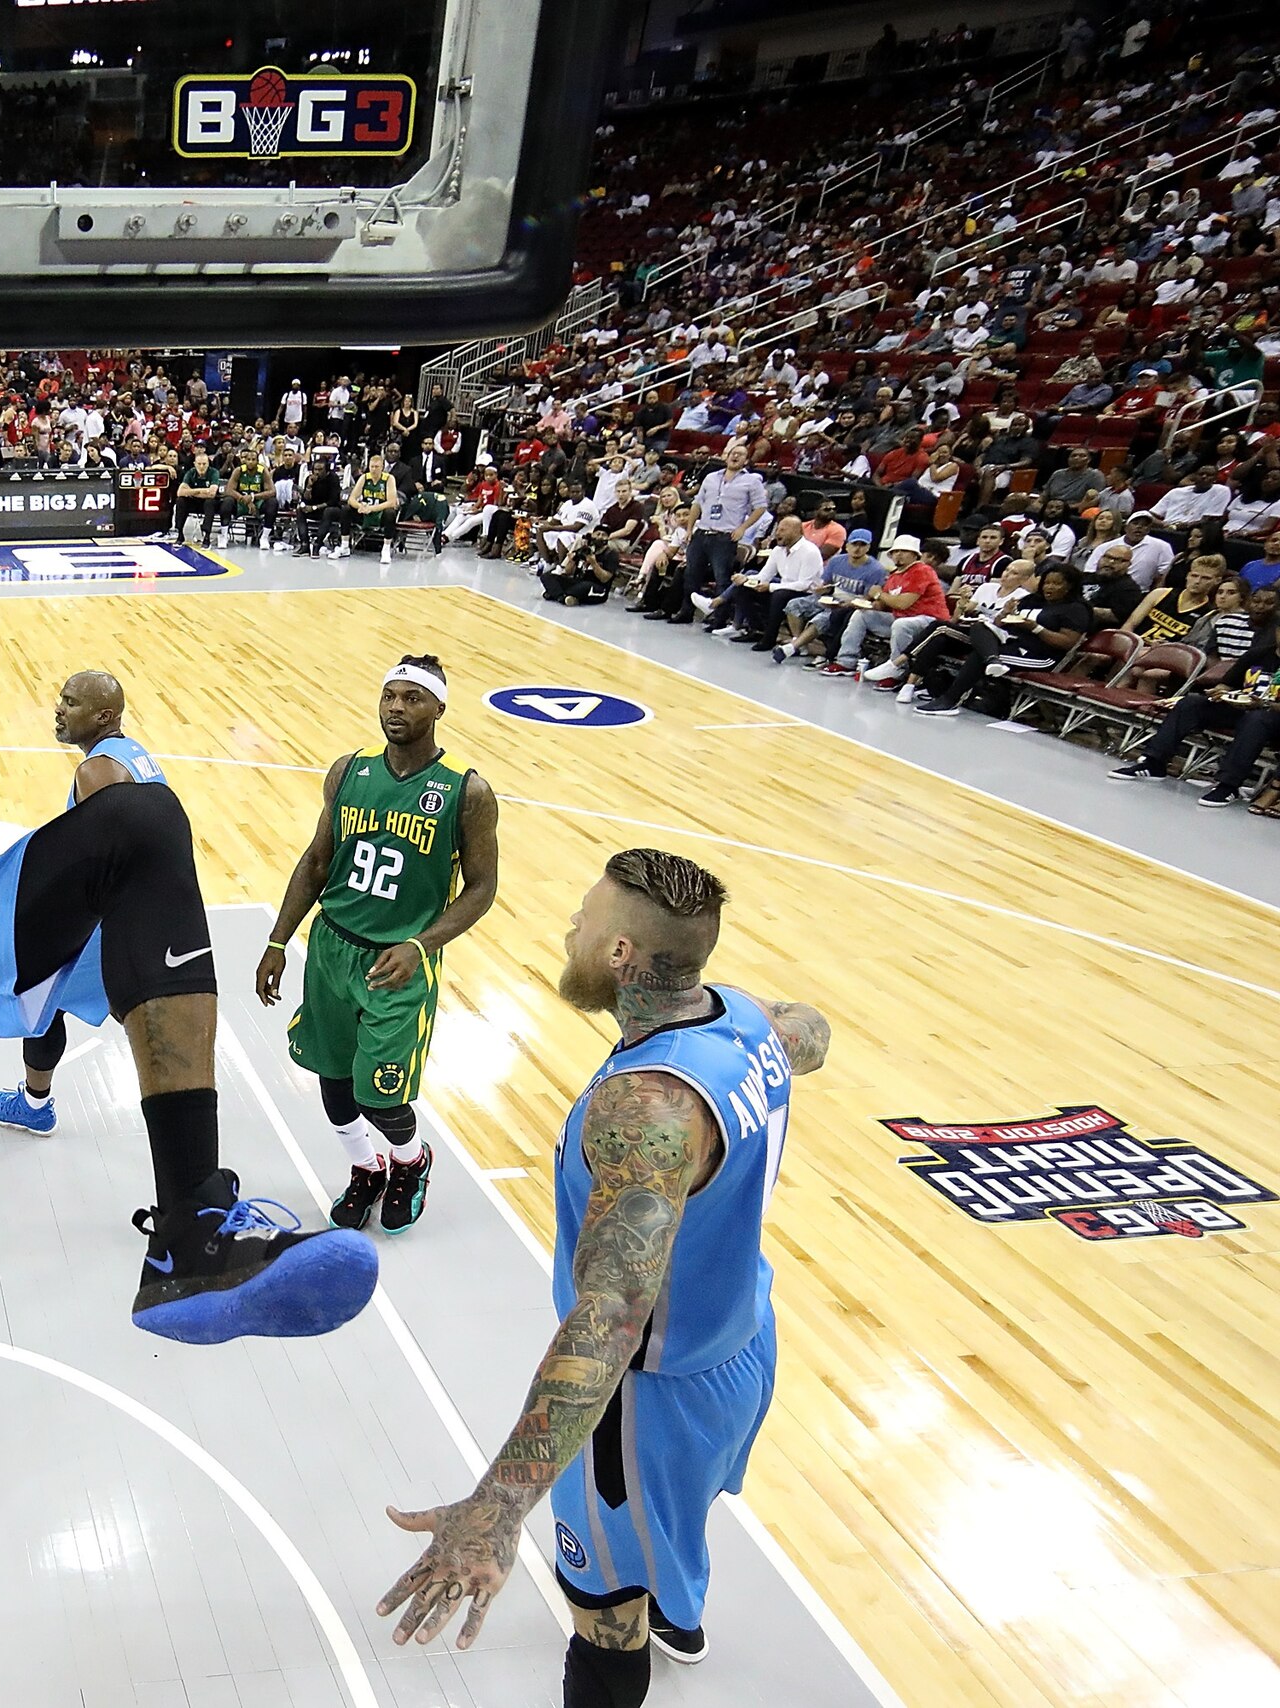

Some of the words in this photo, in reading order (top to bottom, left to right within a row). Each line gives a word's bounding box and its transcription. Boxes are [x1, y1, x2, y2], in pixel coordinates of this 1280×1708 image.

[30, 495, 77, 511] BIG3
[138, 487, 161, 511] 12
[340, 805, 380, 842] BALL
[385, 811, 439, 856] HOGS
[347, 839, 405, 901] 92
[903, 1125, 980, 1142] 2018
[993, 1107, 1110, 1141] HOUSTON
[957, 1137, 1160, 1176] NIGHT
[927, 1153, 1262, 1217] OPENING
